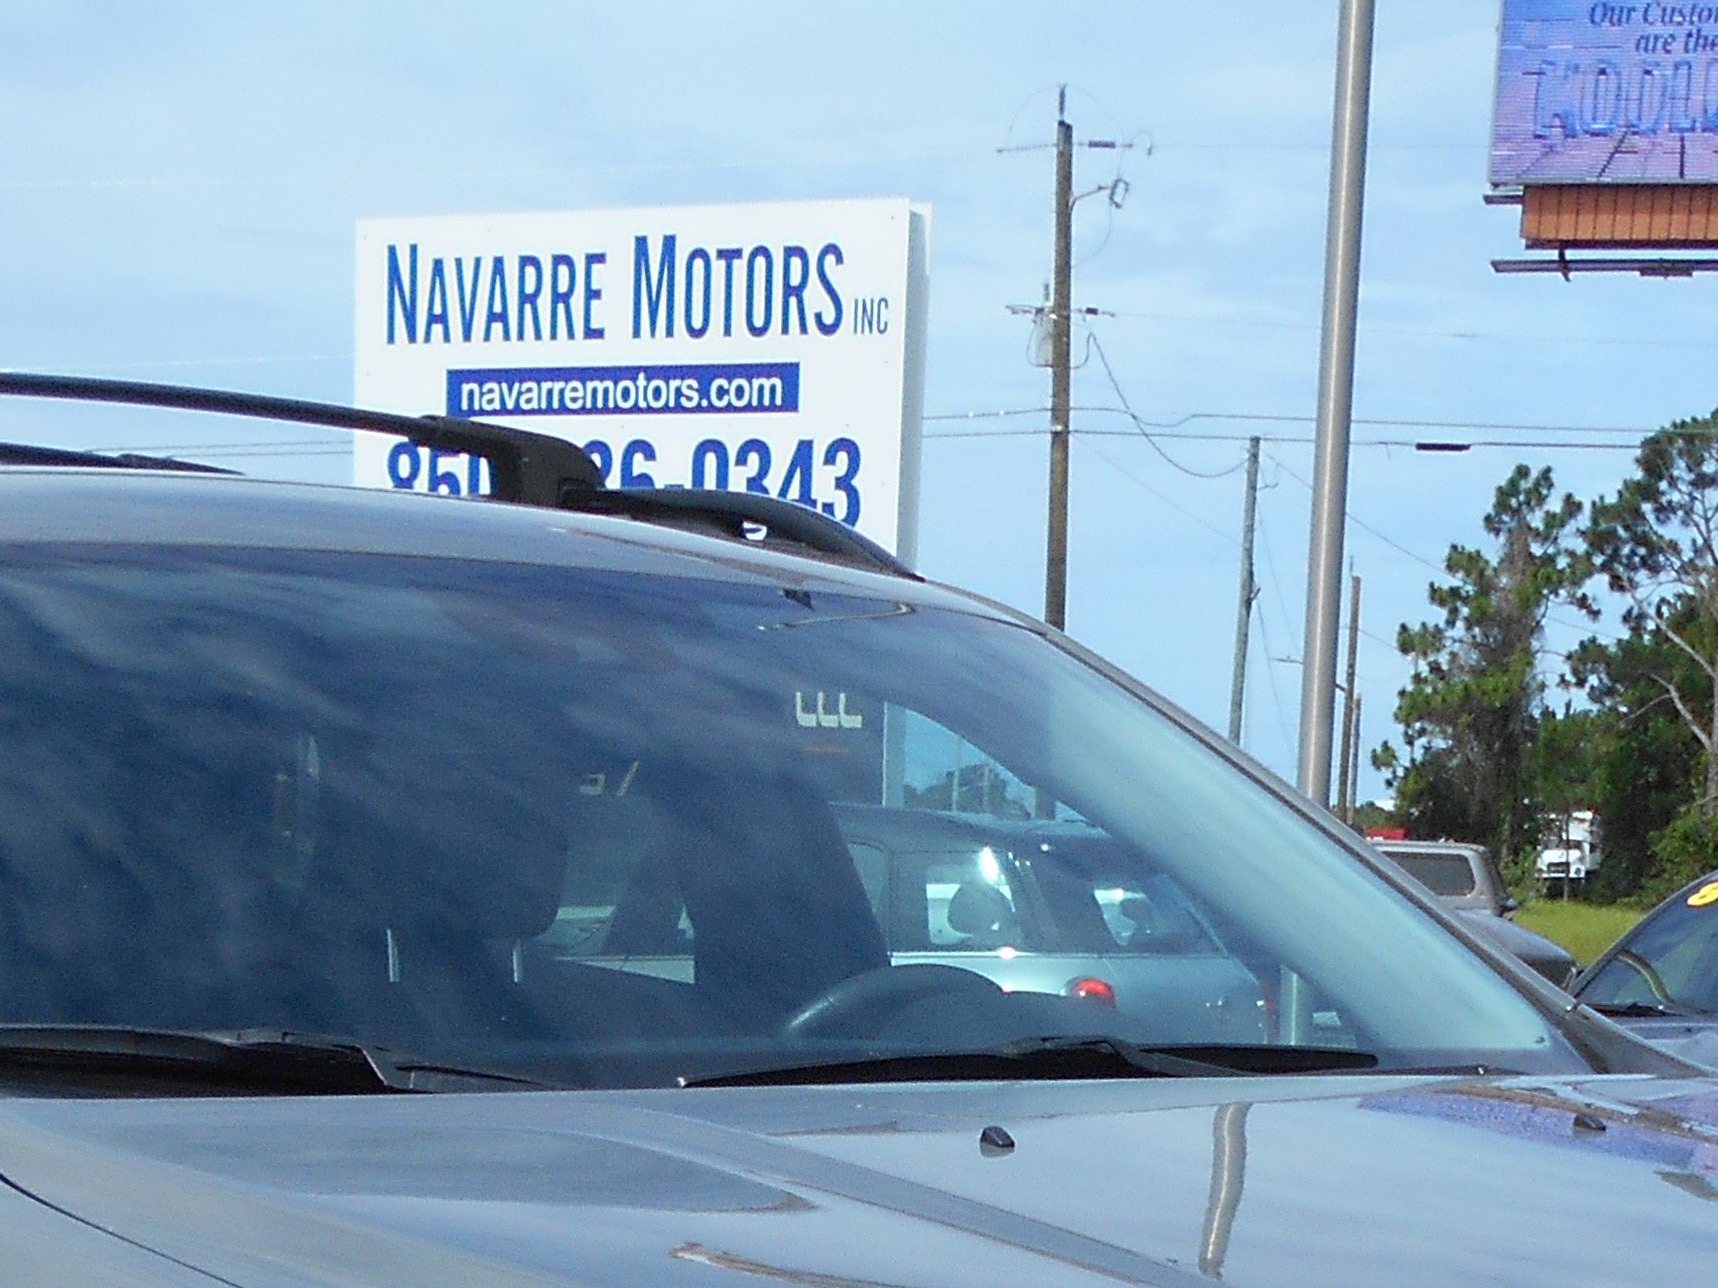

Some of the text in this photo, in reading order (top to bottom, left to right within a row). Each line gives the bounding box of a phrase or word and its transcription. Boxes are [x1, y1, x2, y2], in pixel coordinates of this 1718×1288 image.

[1589, 2, 1637, 27] Our
[1635, 33, 1677, 54] are
[387, 233, 890, 345] NAVARRE MOTORS INC
[460, 370, 783, 411] navarremotors.com
